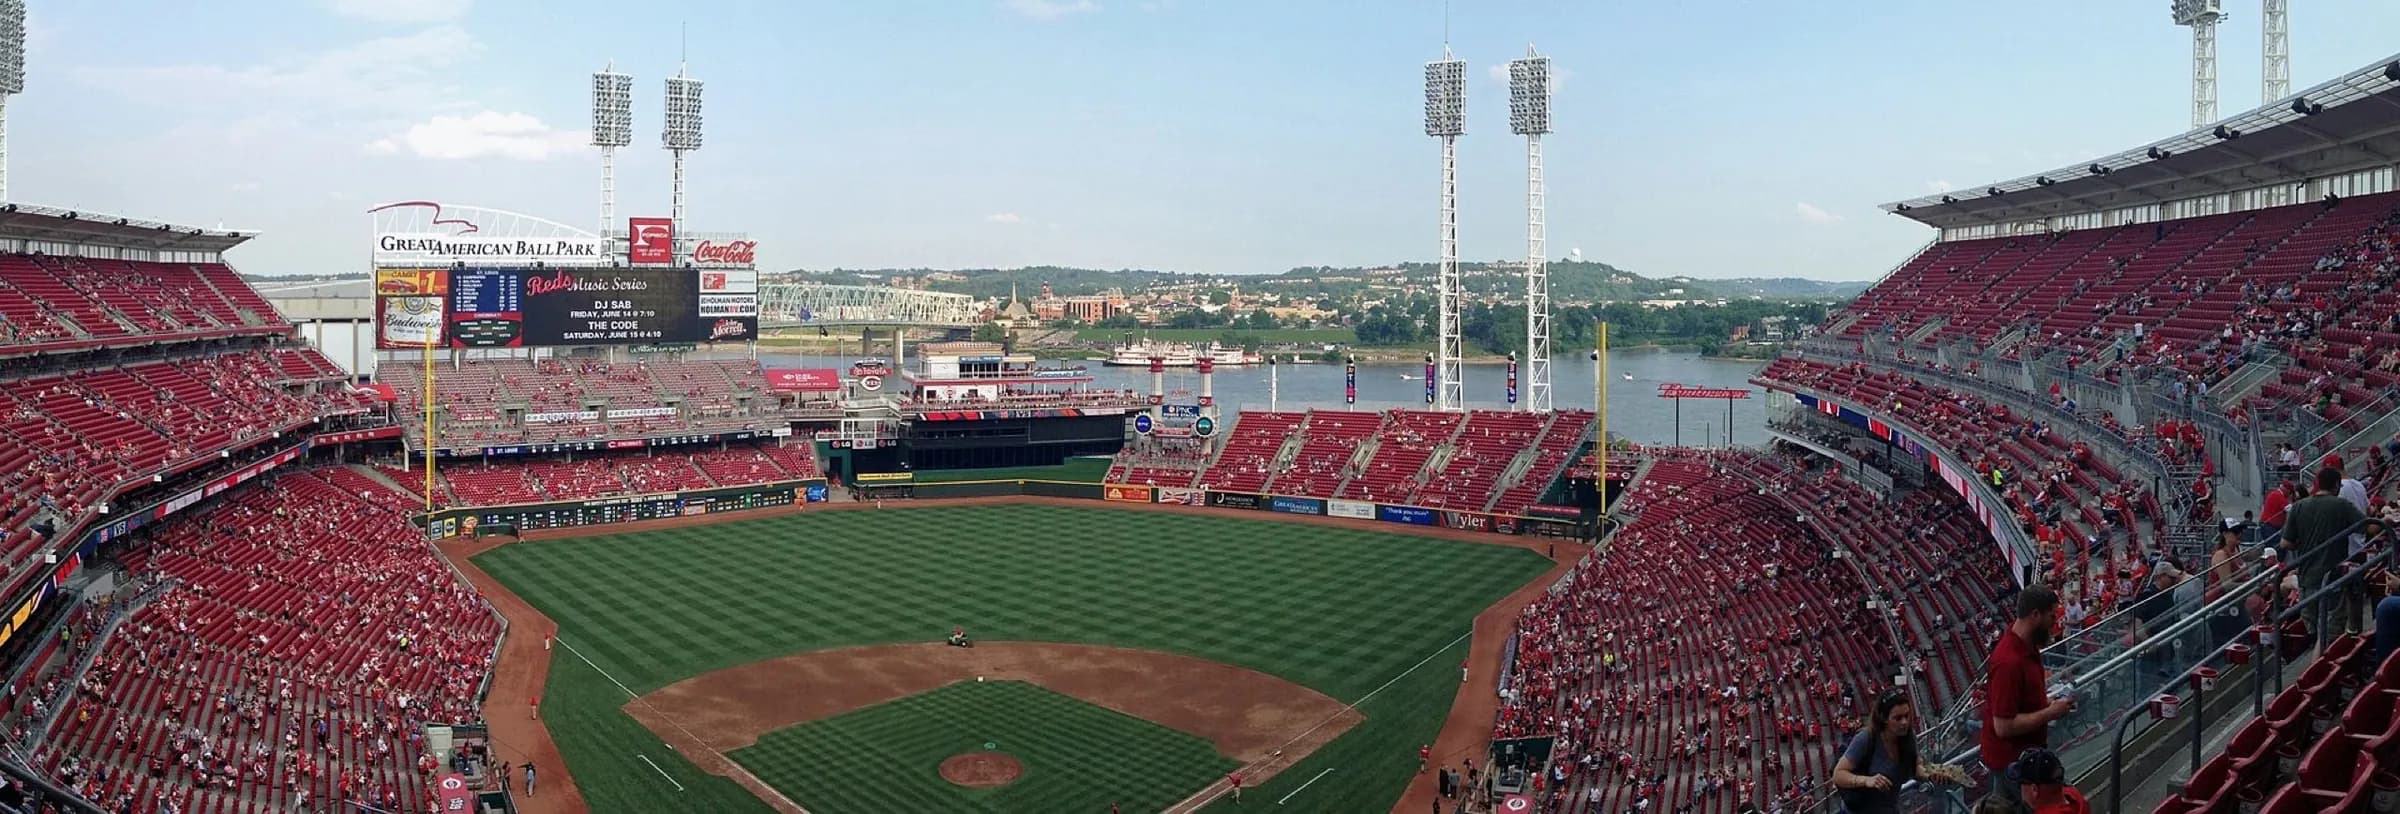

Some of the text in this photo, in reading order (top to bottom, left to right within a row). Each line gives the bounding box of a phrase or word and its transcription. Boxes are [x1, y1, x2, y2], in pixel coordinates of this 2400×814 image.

[381, 236, 595, 256] GREAT AMERICAN BALL PARK
[527, 270, 647, 296] Reds Music Series
[594, 300, 632, 309] DJ SAB
[570, 310, 600, 318] FRIDAY,
[588, 321, 638, 330] THE CODE
